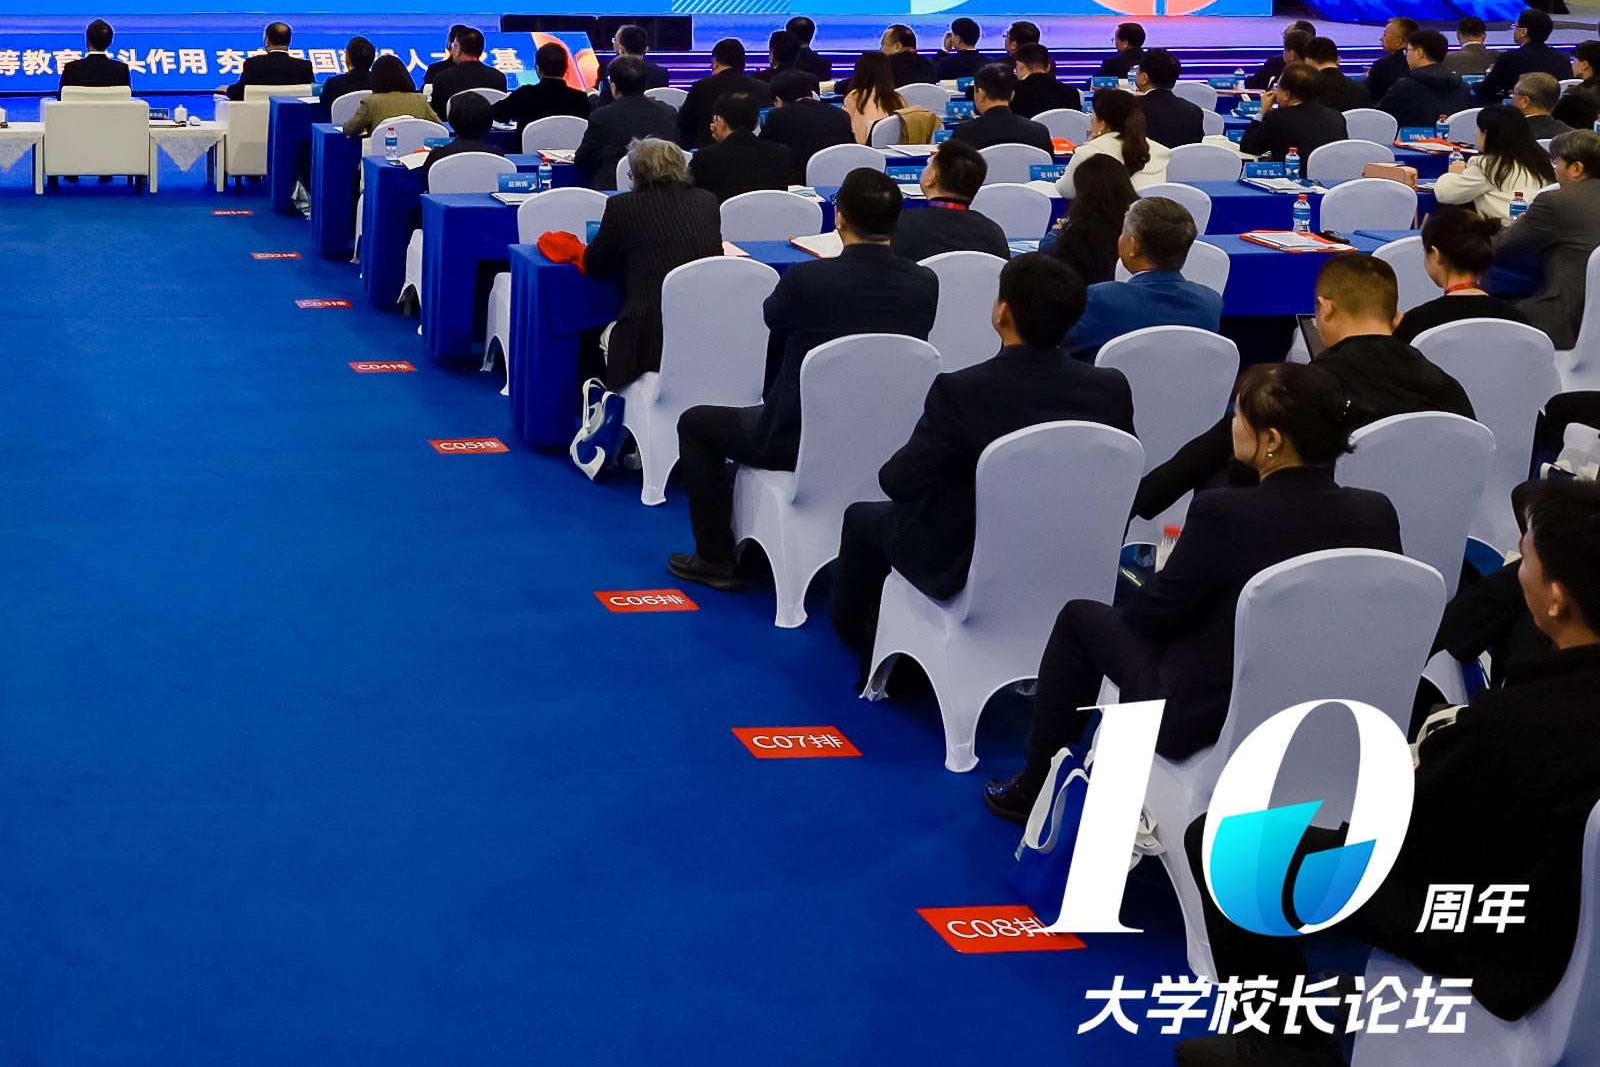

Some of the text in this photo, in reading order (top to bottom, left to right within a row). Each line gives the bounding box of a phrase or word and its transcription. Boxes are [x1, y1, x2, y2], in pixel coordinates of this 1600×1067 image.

[438, 439, 500, 451] C05排
[608, 593, 686, 607] C06排
[751, 733, 845, 750] C07排
